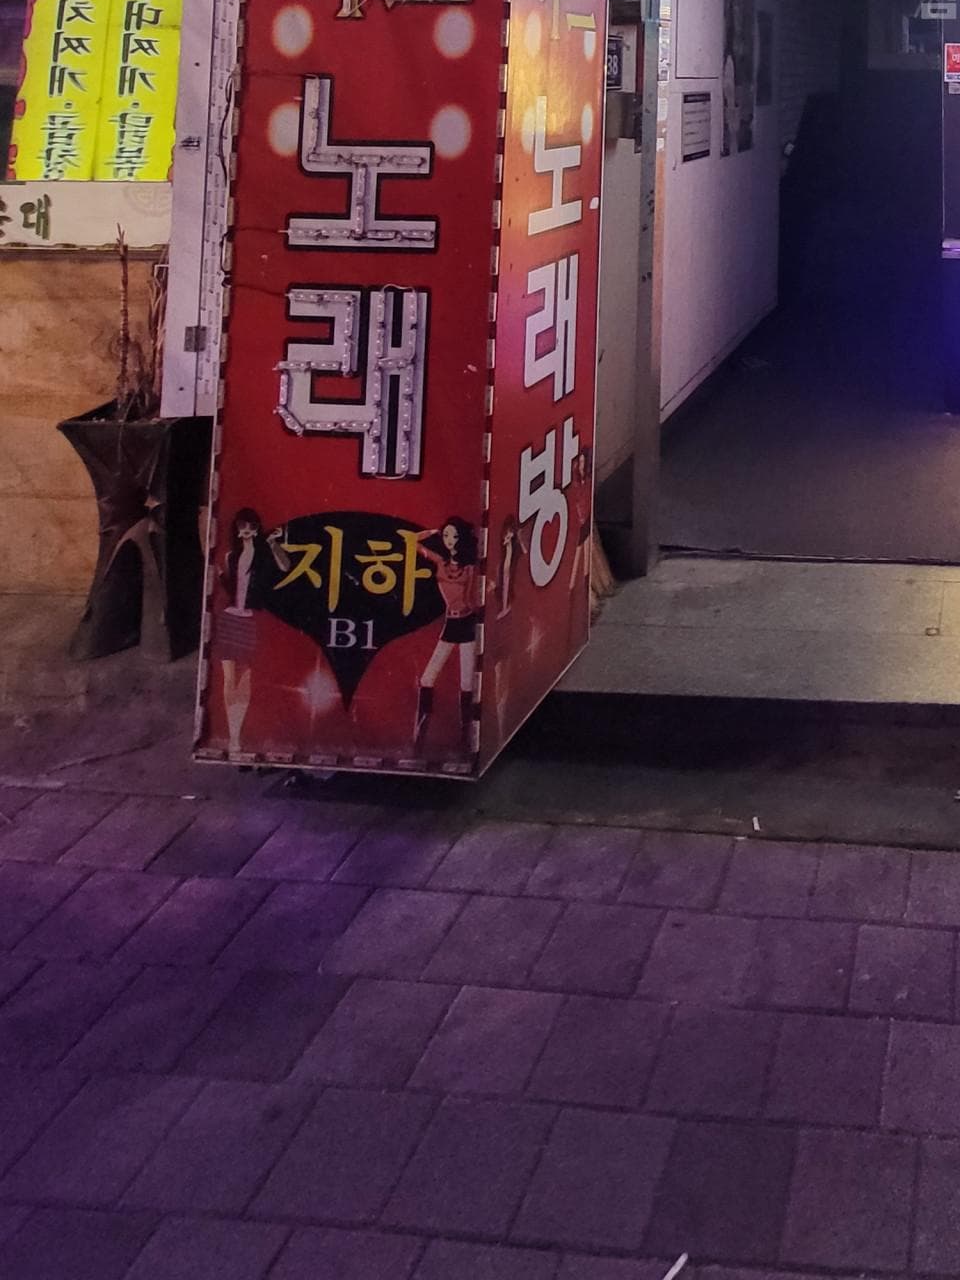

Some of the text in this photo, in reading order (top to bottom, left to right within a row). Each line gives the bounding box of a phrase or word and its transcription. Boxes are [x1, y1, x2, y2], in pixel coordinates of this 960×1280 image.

[519, 95, 583, 587] 노래방
[273, 526, 432, 618] 지하
[326, 617, 378, 651] B1
